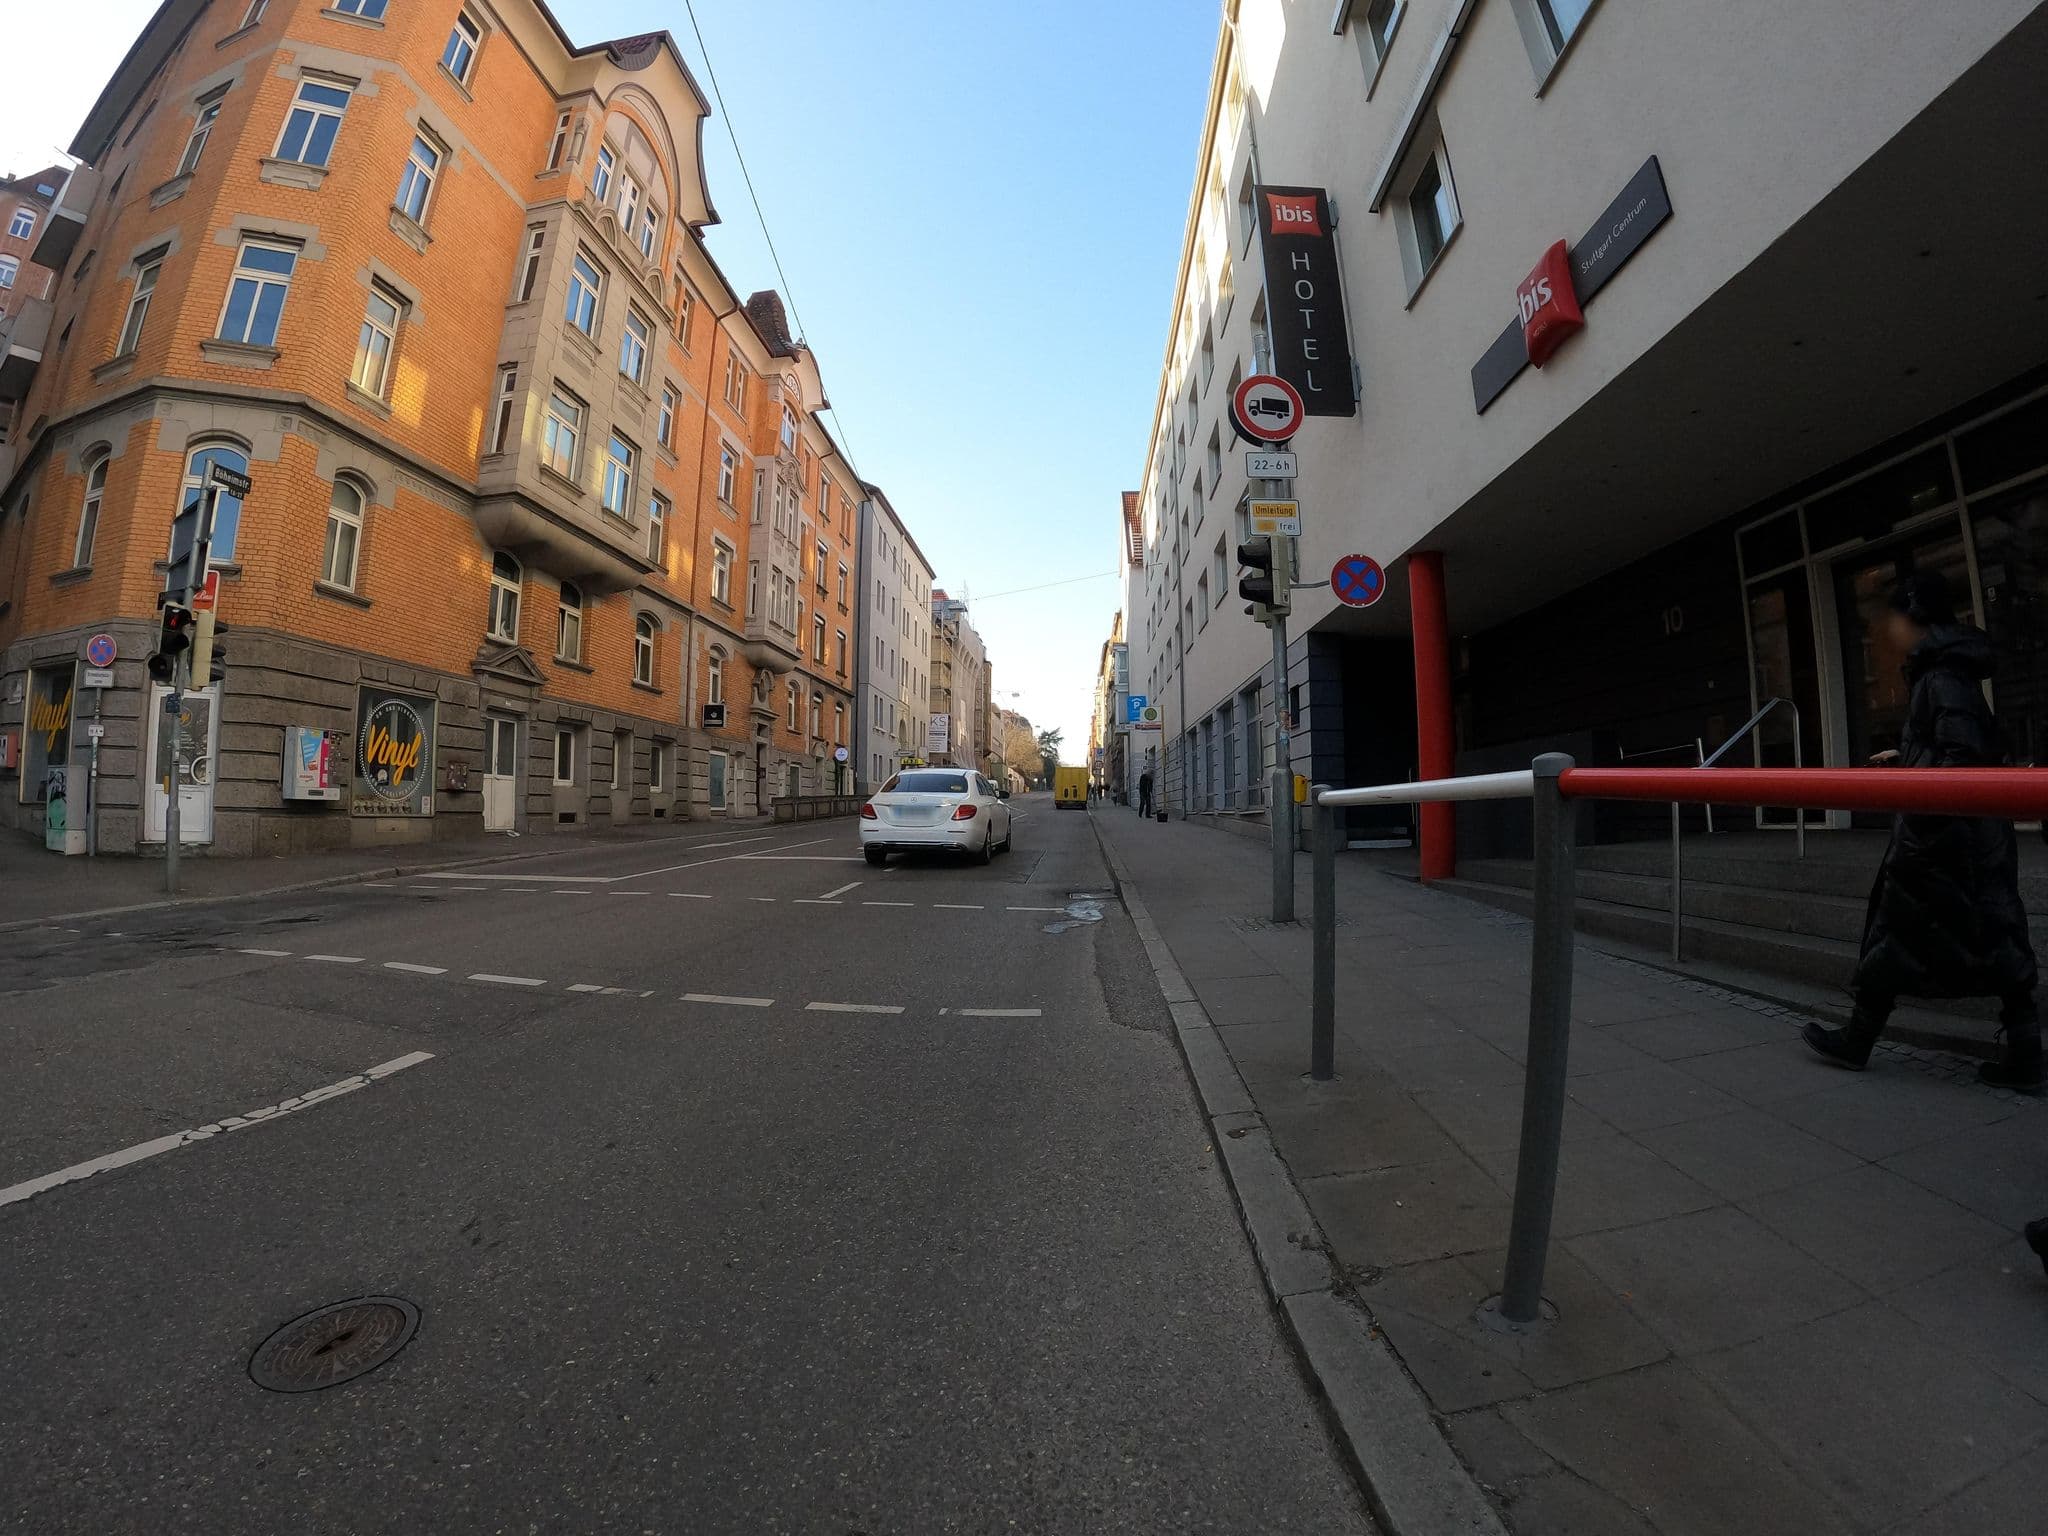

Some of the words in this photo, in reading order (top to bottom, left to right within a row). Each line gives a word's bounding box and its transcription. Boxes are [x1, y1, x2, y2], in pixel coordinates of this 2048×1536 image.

[1276, 204, 1313, 223] ibis
[1580, 235, 1613, 274] Stuttgart
[1612, 197, 1647, 238] Centrum
[1291, 251, 1323, 392] HOTEL
[1255, 505, 1293, 517] Umleitung
[1279, 522, 1296, 531] frei
[1662, 605, 1683, 636] 10
[367, 724, 422, 787] Vinyl
